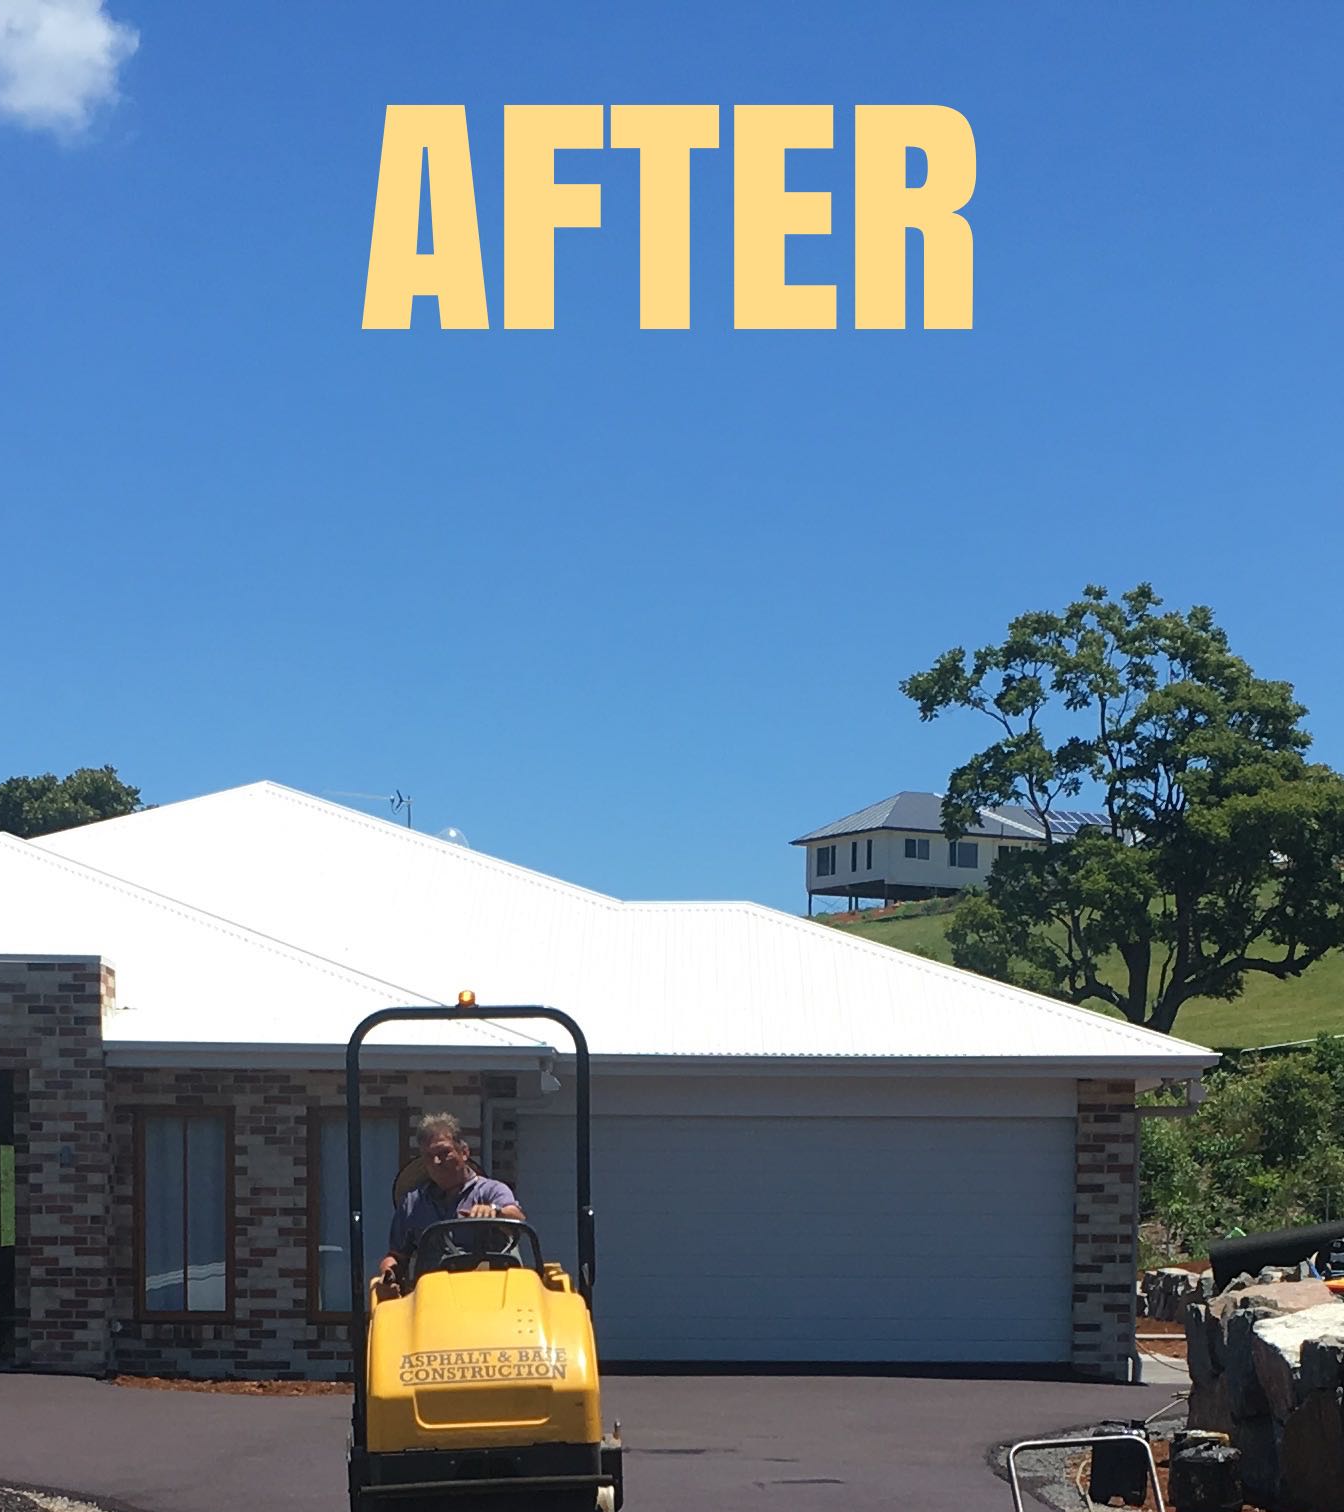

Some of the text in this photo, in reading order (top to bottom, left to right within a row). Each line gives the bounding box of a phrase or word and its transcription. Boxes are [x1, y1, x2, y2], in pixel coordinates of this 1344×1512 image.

[400, 1350, 567, 1369] ASPHALT & BASE
[400, 1363, 567, 1382] CONSTRUCTION
